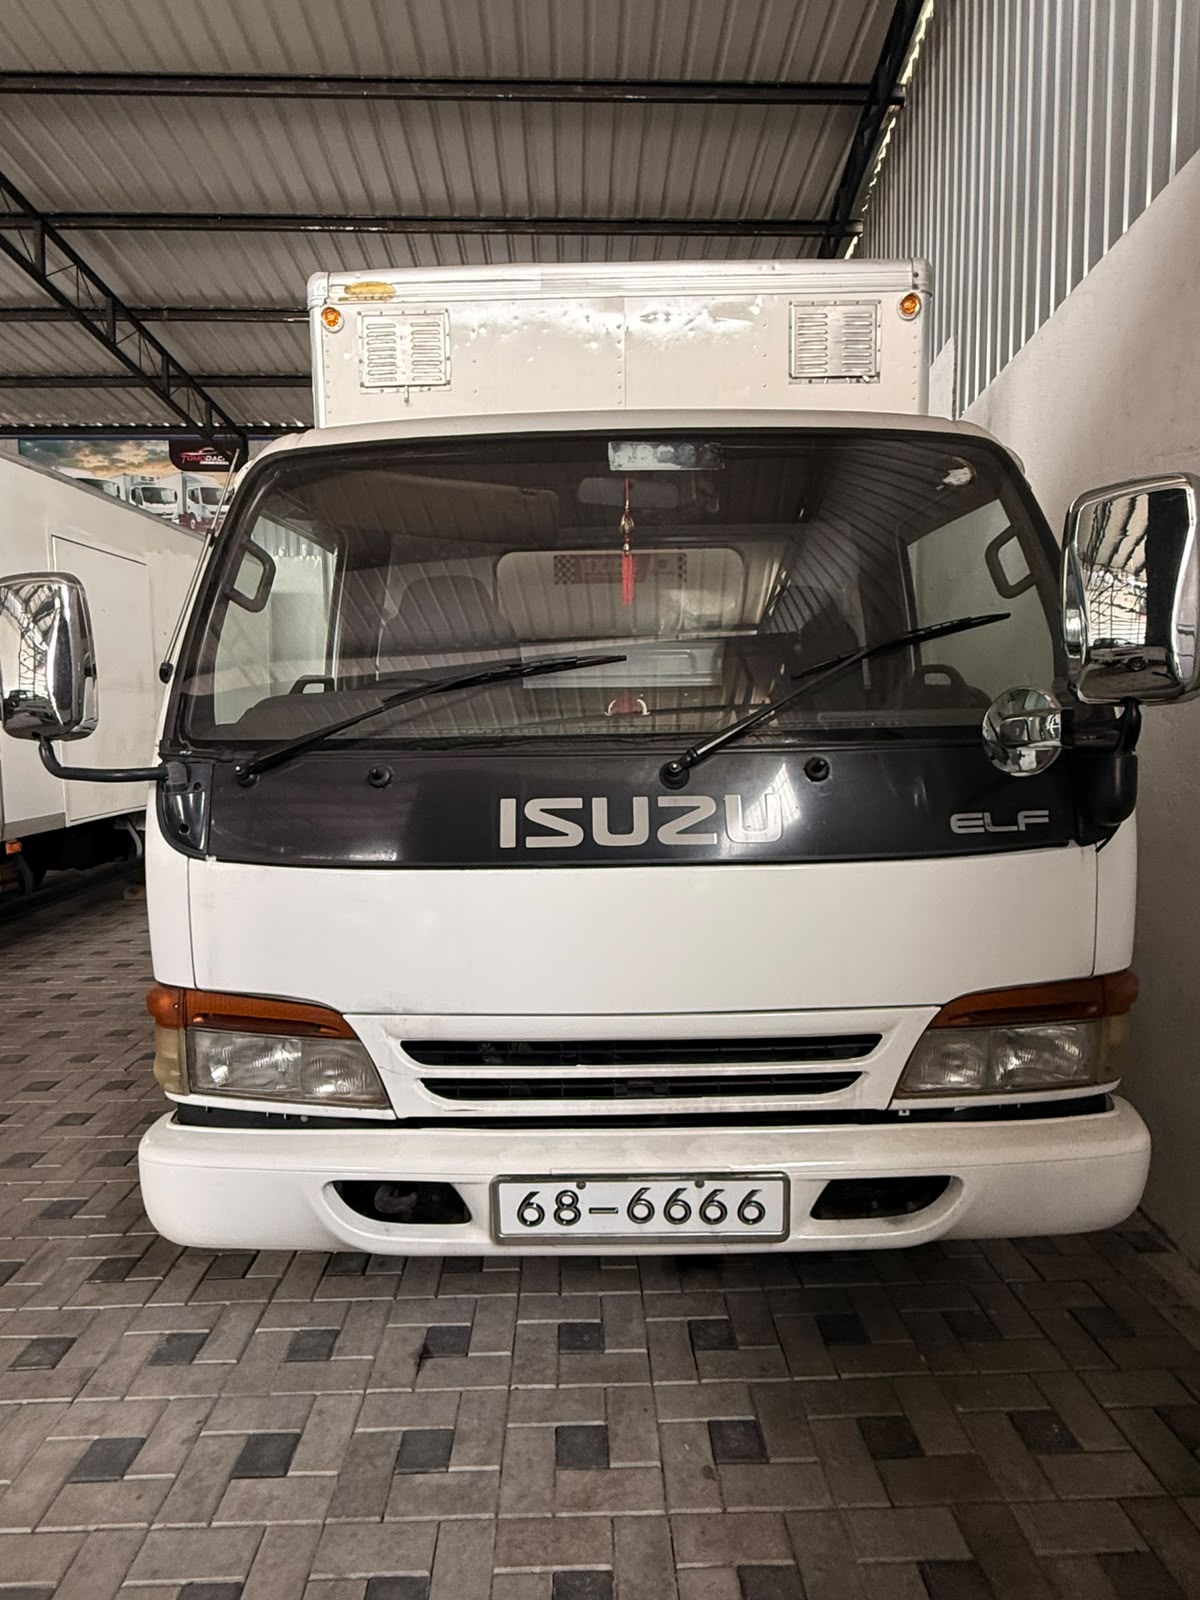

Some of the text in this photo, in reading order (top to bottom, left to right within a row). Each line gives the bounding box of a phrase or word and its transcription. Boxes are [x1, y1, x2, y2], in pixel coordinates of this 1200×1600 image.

[181, 454, 225, 464] TOMODAC
[499, 794, 784, 848] ISUZU
[950, 809, 1050, 834] ELF
[516, 1187, 766, 1227] 68-6666
